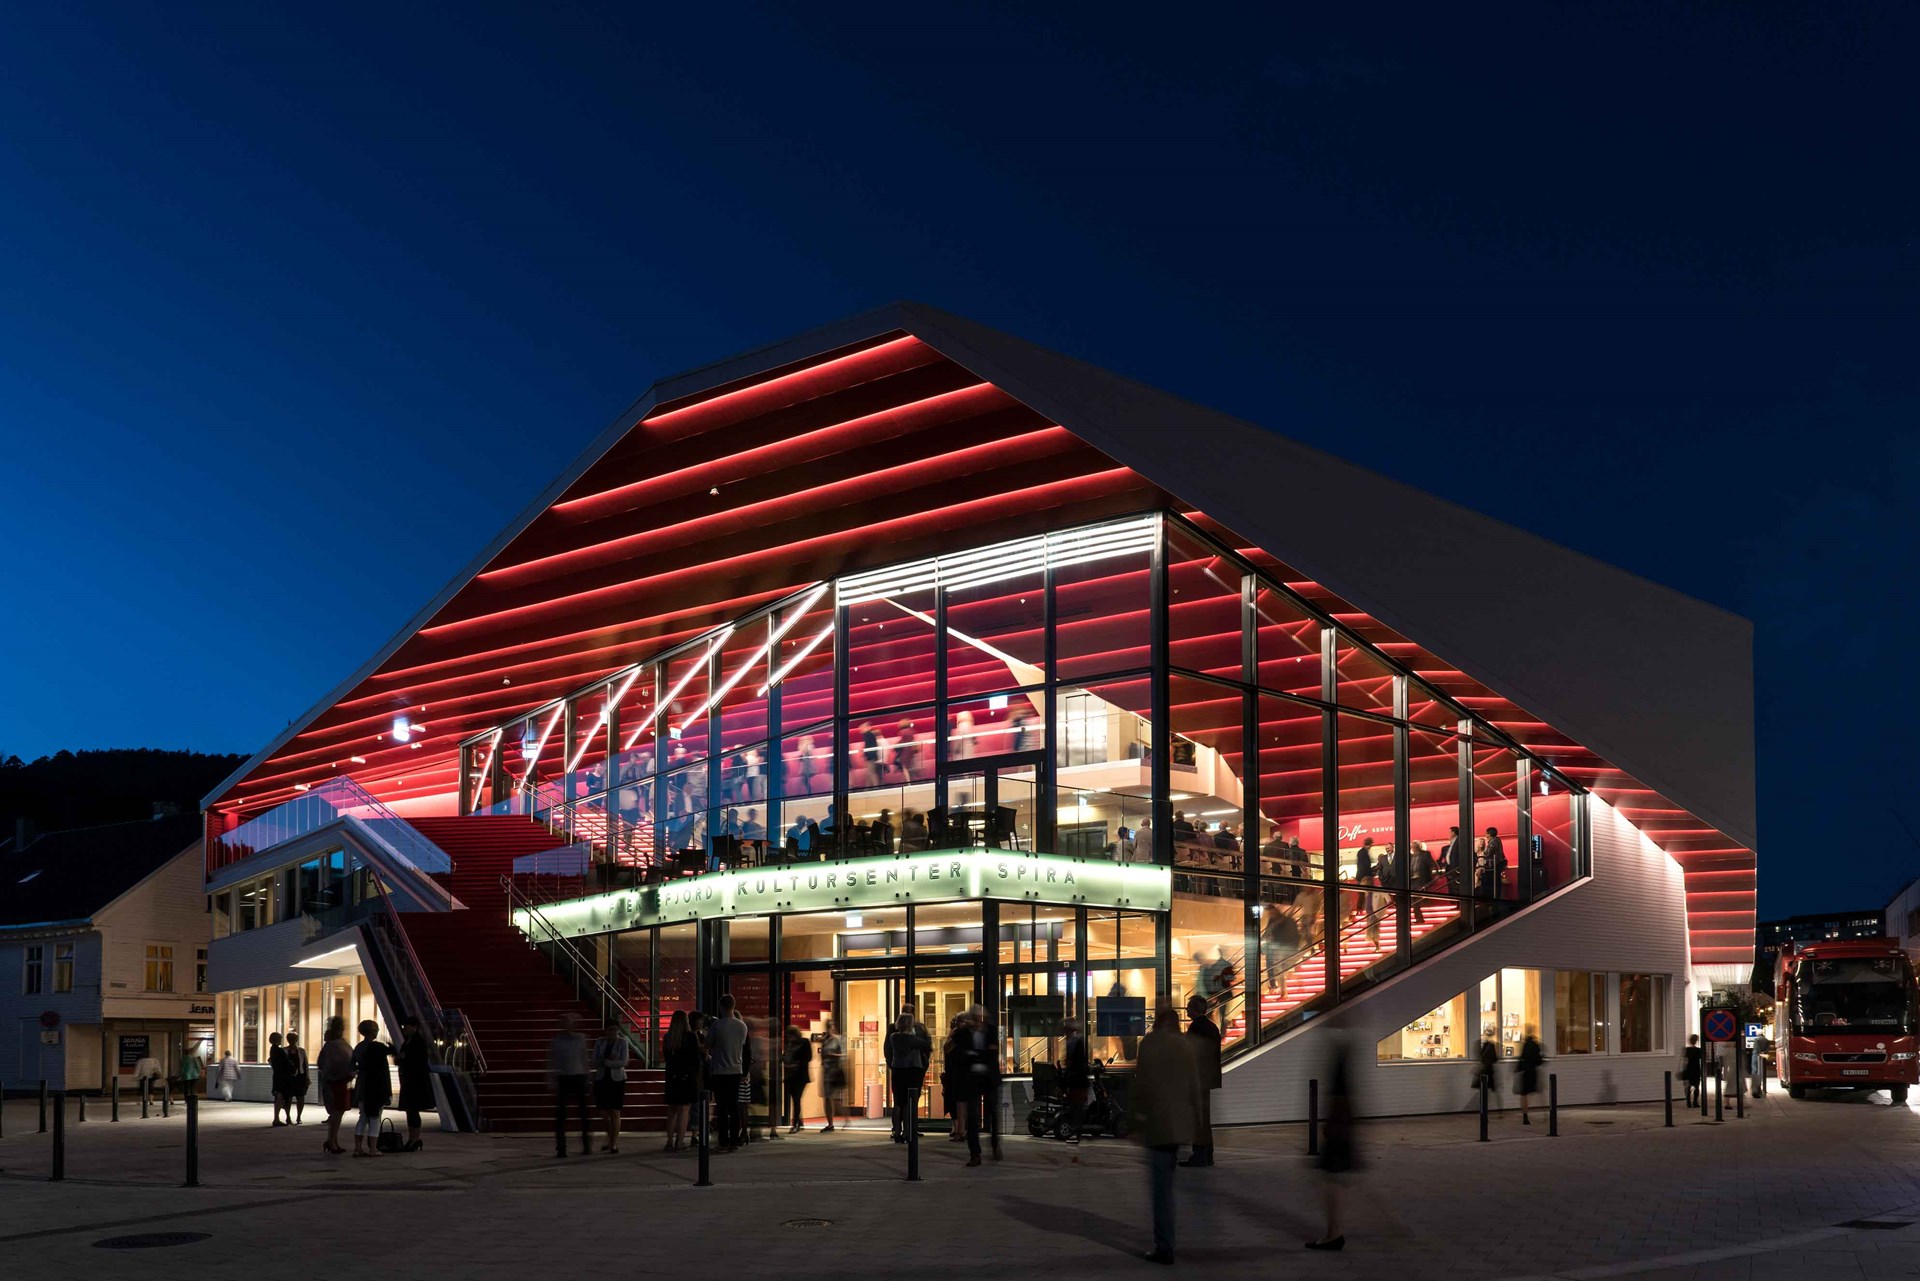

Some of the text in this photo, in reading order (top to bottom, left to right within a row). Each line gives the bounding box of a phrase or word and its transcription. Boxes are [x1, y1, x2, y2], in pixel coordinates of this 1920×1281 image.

[737, 861, 962, 895] KULTURSENTER
[998, 862, 1075, 885] SPIRA
[1749, 1024, 1758, 1036] P
